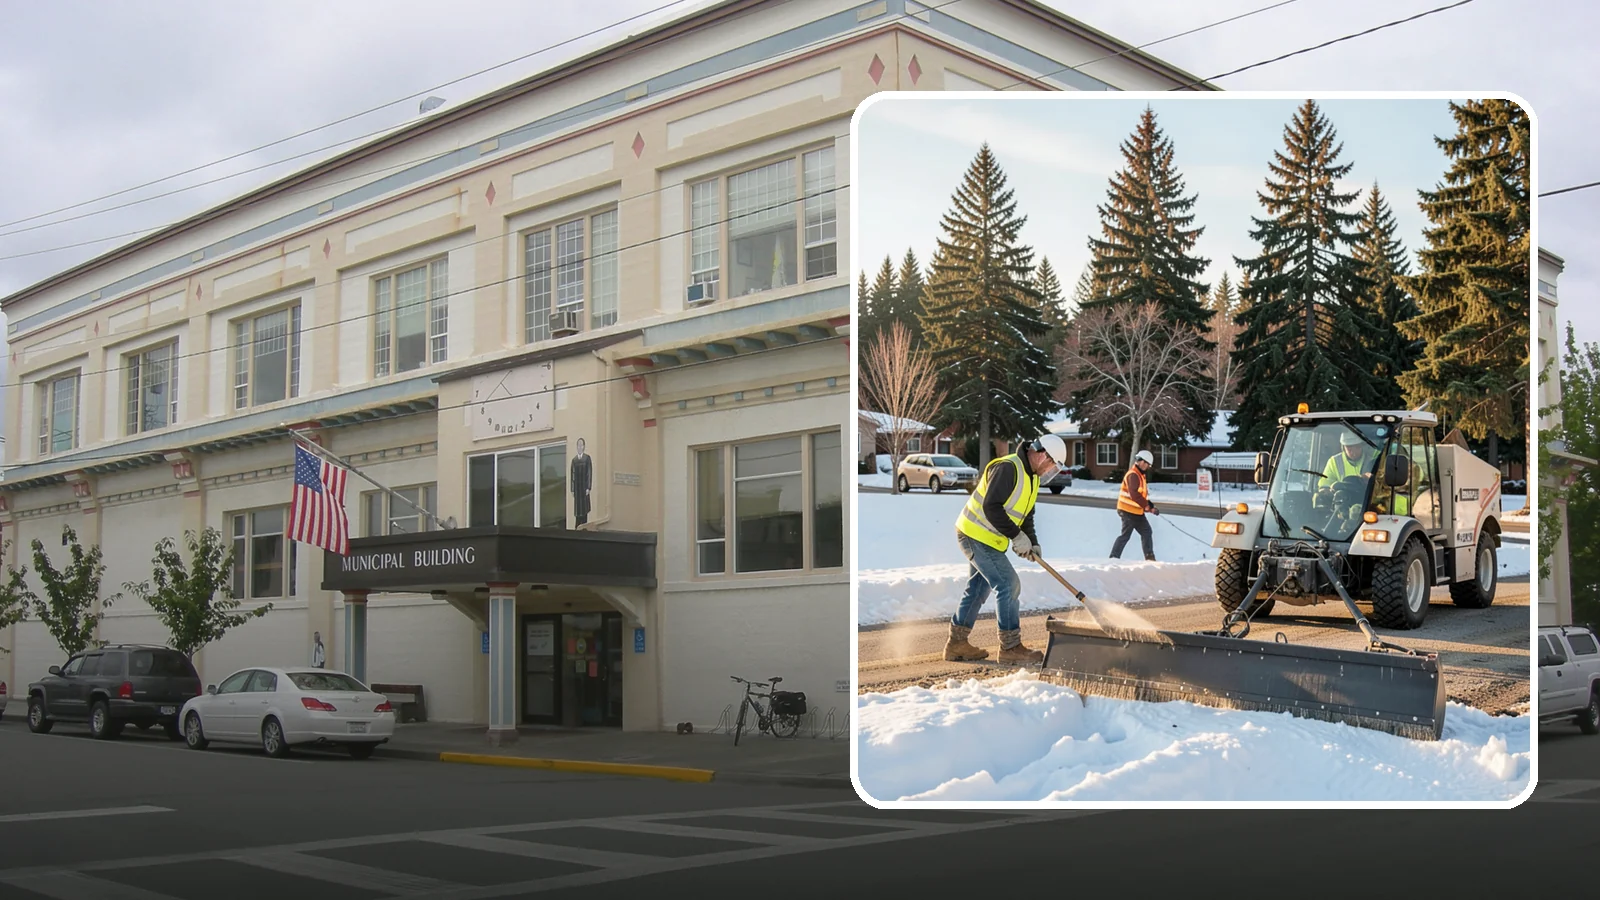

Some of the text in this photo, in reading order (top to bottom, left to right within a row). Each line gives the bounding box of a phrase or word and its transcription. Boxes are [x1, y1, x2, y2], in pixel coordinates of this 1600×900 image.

[546, 362, 552, 370] 6
[475, 390, 479, 398] 7
[536, 402, 540, 410] 4
[480, 407, 485, 415] 8
[488, 418, 493, 426] 9
[529, 414, 533, 422] 3
[521, 420, 526, 428] 2
[507, 425, 513, 433] 12
[342, 546, 475, 572] MUNICIPAL BUILDING
